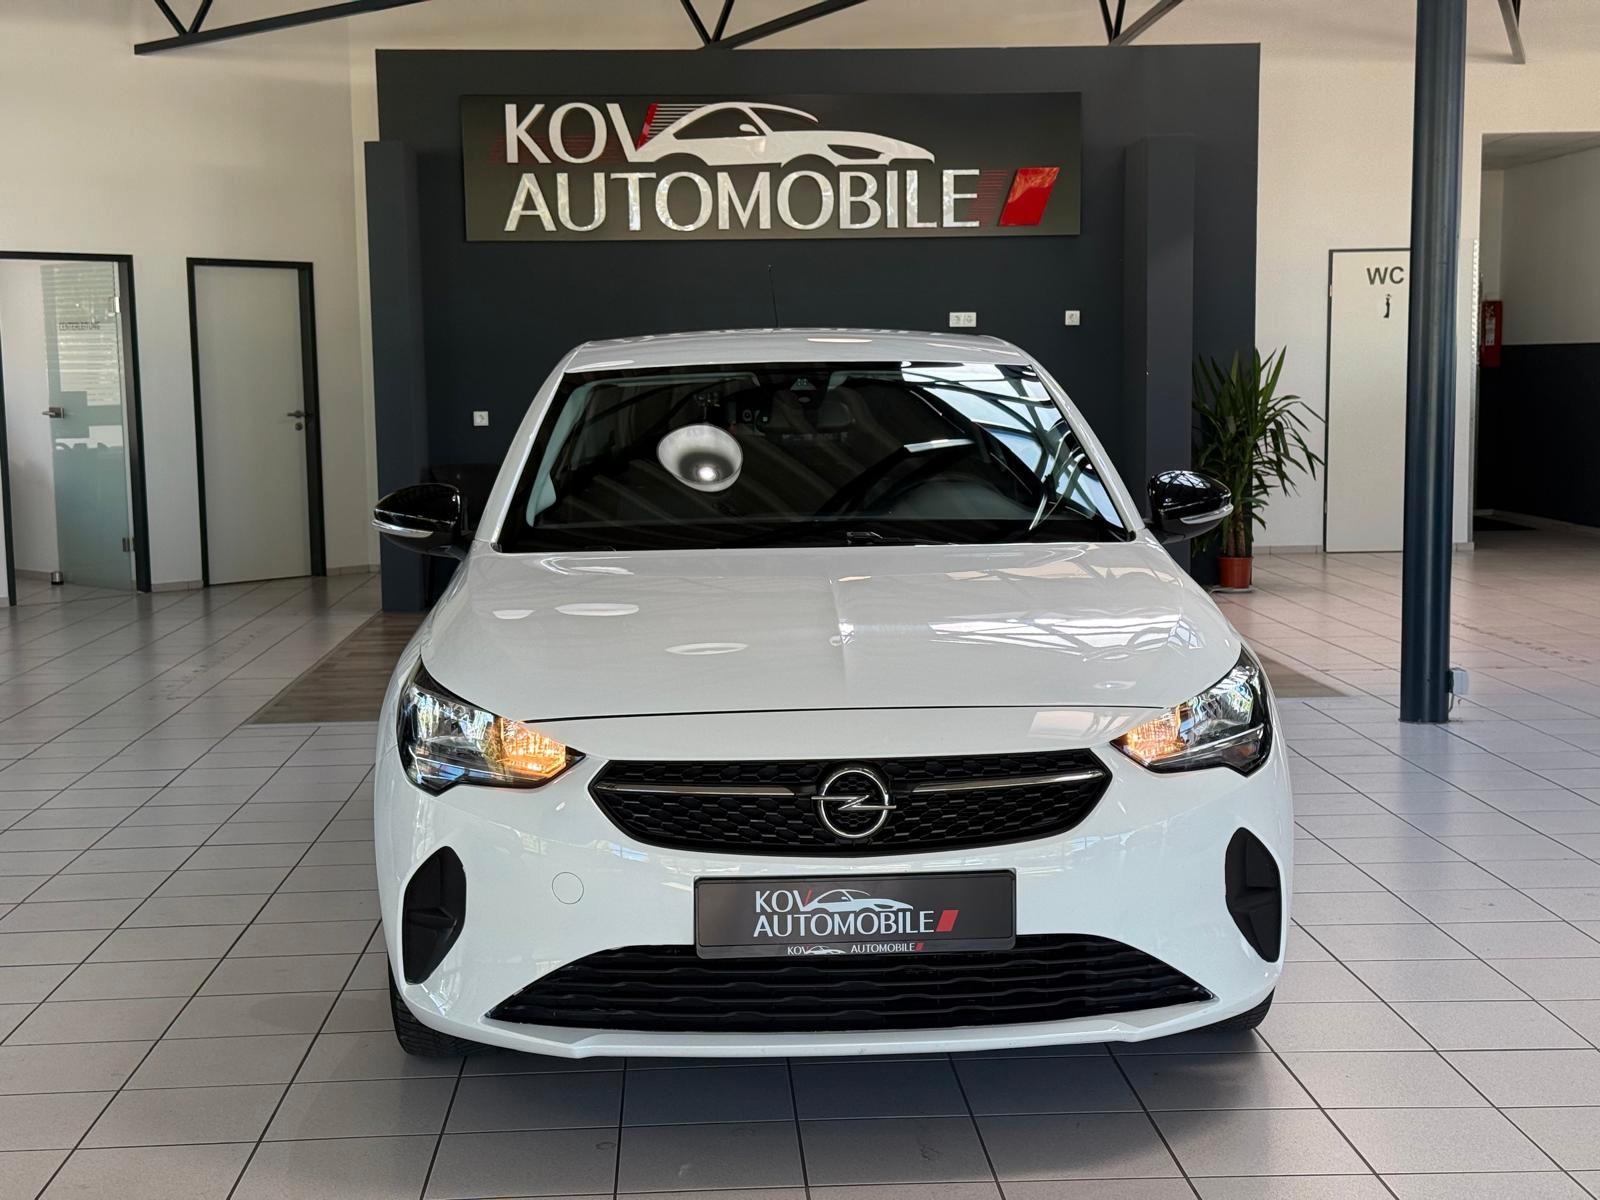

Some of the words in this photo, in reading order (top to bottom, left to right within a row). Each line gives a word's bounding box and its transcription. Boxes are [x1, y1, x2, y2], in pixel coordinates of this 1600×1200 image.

[504, 102, 657, 164] KOV
[503, 168, 981, 232] AUTOMOBILE
[1366, 266, 1404, 285] WC
[755, 889, 813, 913] KOV
[753, 910, 935, 937] AUTOMOBILE
[787, 944, 809, 956] KOV
[850, 942, 916, 954] AUTOMOBILE
